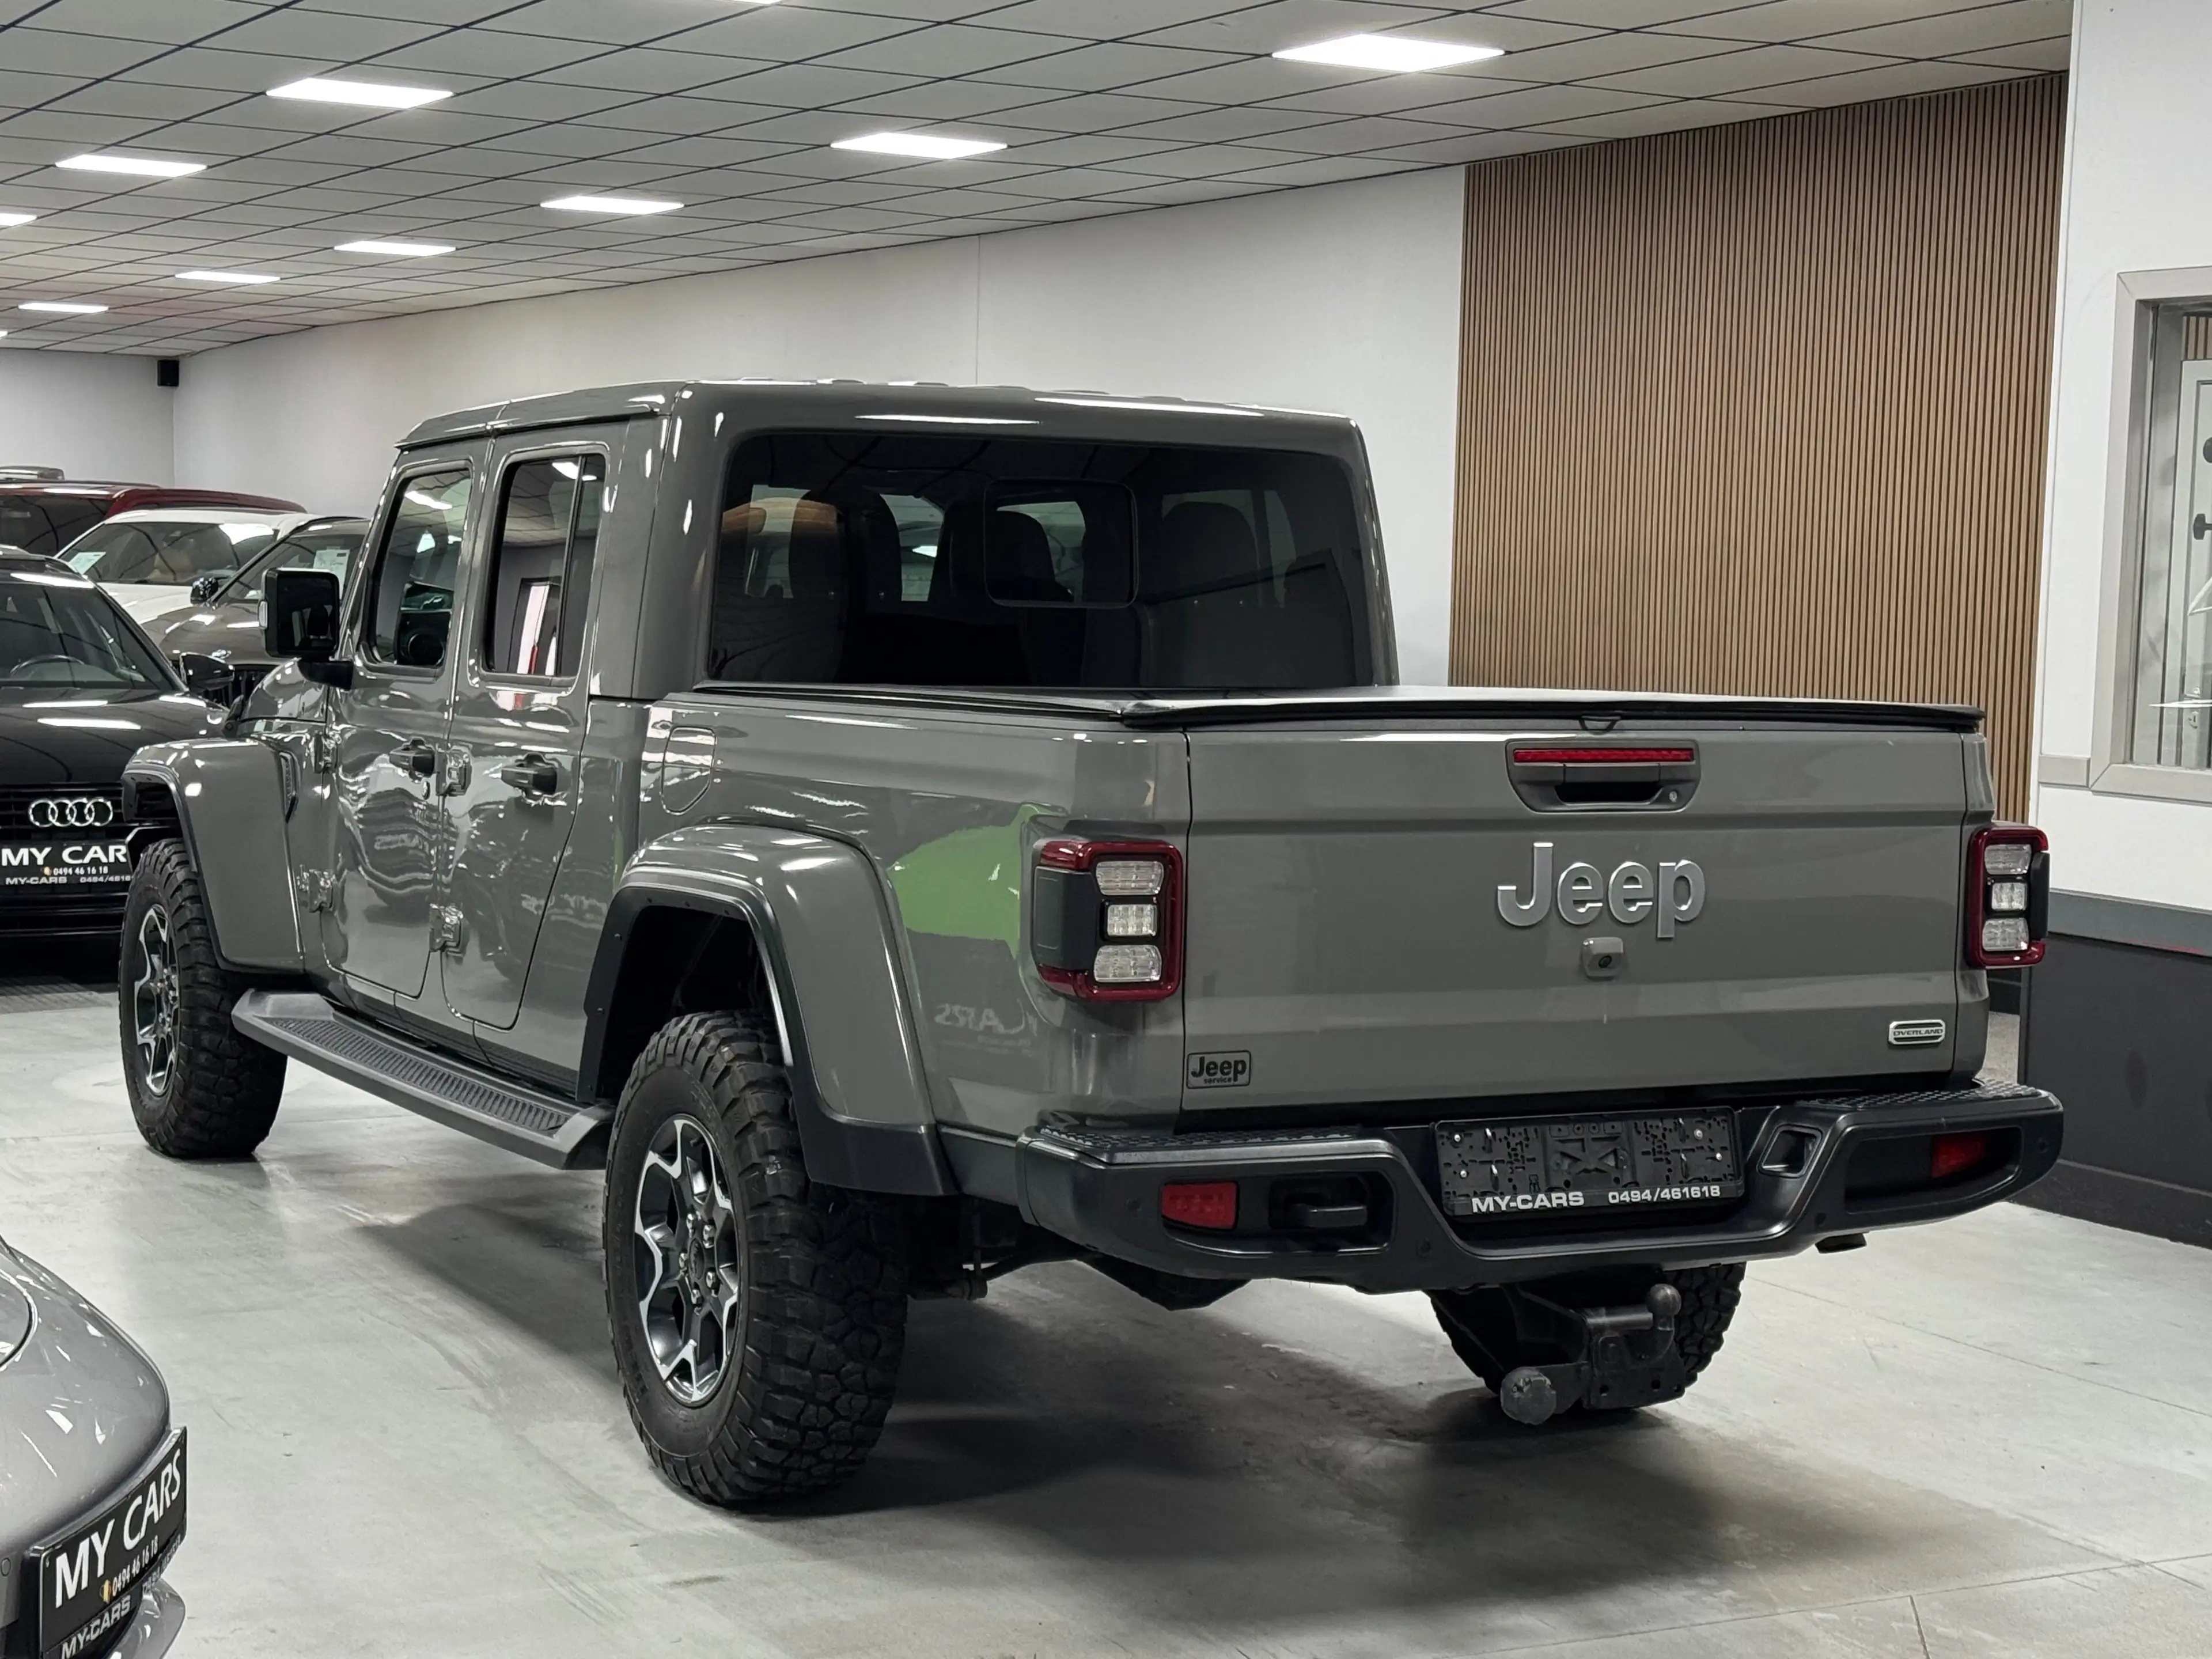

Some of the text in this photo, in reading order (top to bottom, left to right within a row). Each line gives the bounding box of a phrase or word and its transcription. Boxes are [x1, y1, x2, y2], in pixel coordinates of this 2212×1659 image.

[1, 845, 127, 866] MY CAR
[74, 867, 85, 875] 46
[87, 866, 97, 874] 16
[1497, 842, 1706, 938] Jeep
[1893, 1028, 1944, 1036] OVERLAND
[1191, 1056, 1247, 1082] Jeep
[1471, 1185, 1721, 1213] MY-CARS 0494/461618
[55, 1518, 115, 1609] MY
[123, 1448, 181, 1551] CARS
[112, 1535, 158, 1597] 0494 46 16 18
[61, 1594, 132, 1659] MY-CARS
